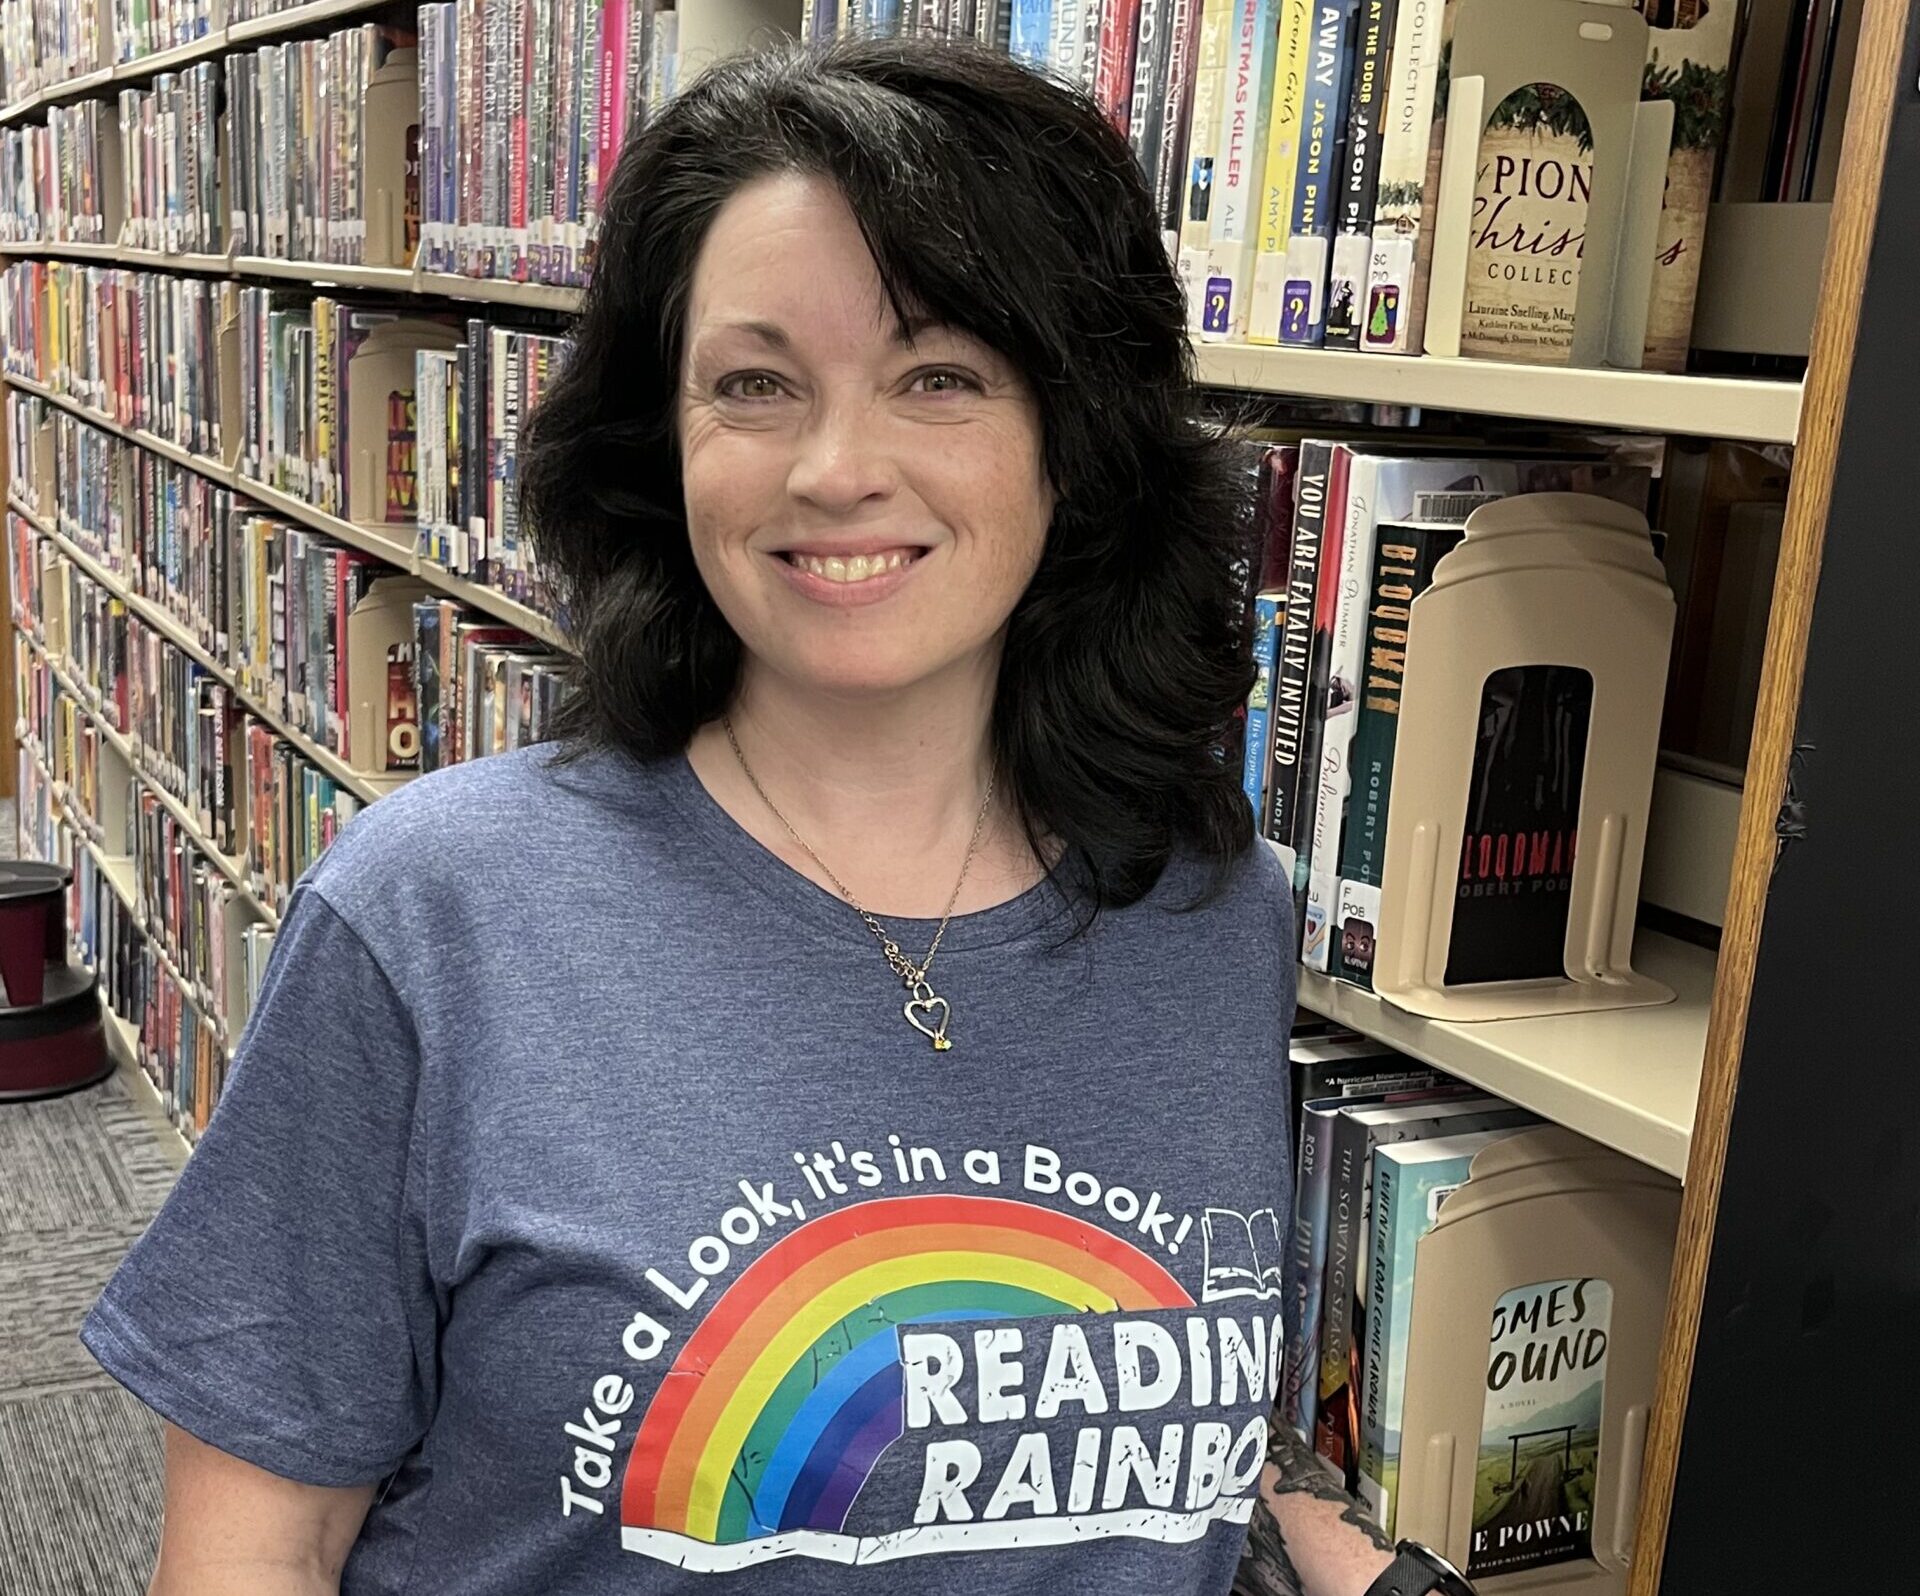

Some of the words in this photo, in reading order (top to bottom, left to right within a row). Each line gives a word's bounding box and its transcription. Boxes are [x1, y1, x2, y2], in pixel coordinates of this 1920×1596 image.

[1369, 1, 1382, 21] AT
[1315, 7, 1340, 87] AWAY
[1365, 25, 1379, 56] THE
[1402, 1, 1426, 134] COLLECTION
[604, 50, 613, 107] CRIMSON
[1280, 71, 1297, 125] Girls
[1360, 61, 1375, 104] DOOR
[602, 111, 611, 149] RIVER
[1226, 109, 1246, 188] KILLER
[1307, 99, 1326, 175] JASON
[1350, 114, 1369, 192] JASON
[1268, 186, 1280, 230] AMY
[1371, 270, 1389, 284] PIO
[1373, 253, 1387, 266] SC
[1487, 262, 1583, 286] COLLEC
[506, 353, 519, 410] THOMAS
[1300, 474, 1325, 519] YOU
[1292, 527, 1317, 573] ARE
[1343, 496, 1368, 573] JONATHAN
[1284, 580, 1313, 671] FATALLY
[1338, 579, 1360, 649] PLUMMER
[1274, 677, 1304, 766] INVITED
[1273, 787, 1284, 825] ANDE
[1362, 761, 1382, 842] ROBERT
[1342, 902, 1365, 918] POB
[1344, 887, 1352, 898] F
[793, 1140, 882, 1200] it's
[887, 1134, 947, 1183] in
[963, 1147, 1000, 1185] a
[1303, 1133, 1316, 1176] RORY
[1342, 1149, 1352, 1177] THE
[1022, 1143, 1194, 1256] Book!
[1378, 1171, 1392, 1229] WHEN
[644, 1179, 806, 1311] Look,
[1332, 1186, 1351, 1287] SOWING
[1372, 1257, 1388, 1304] ROAD
[622, 1311, 671, 1361] a
[1328, 1291, 1345, 1388] SEASON
[1370, 1305, 1384, 1358] COMES
[1486, 1328, 1608, 1393] OUND
[1366, 1358, 1381, 1430] AROUND
[560, 1374, 635, 1518] Take
[912, 1414, 1269, 1524] RAINBO
[1498, 1510, 1589, 1548] POWNE
